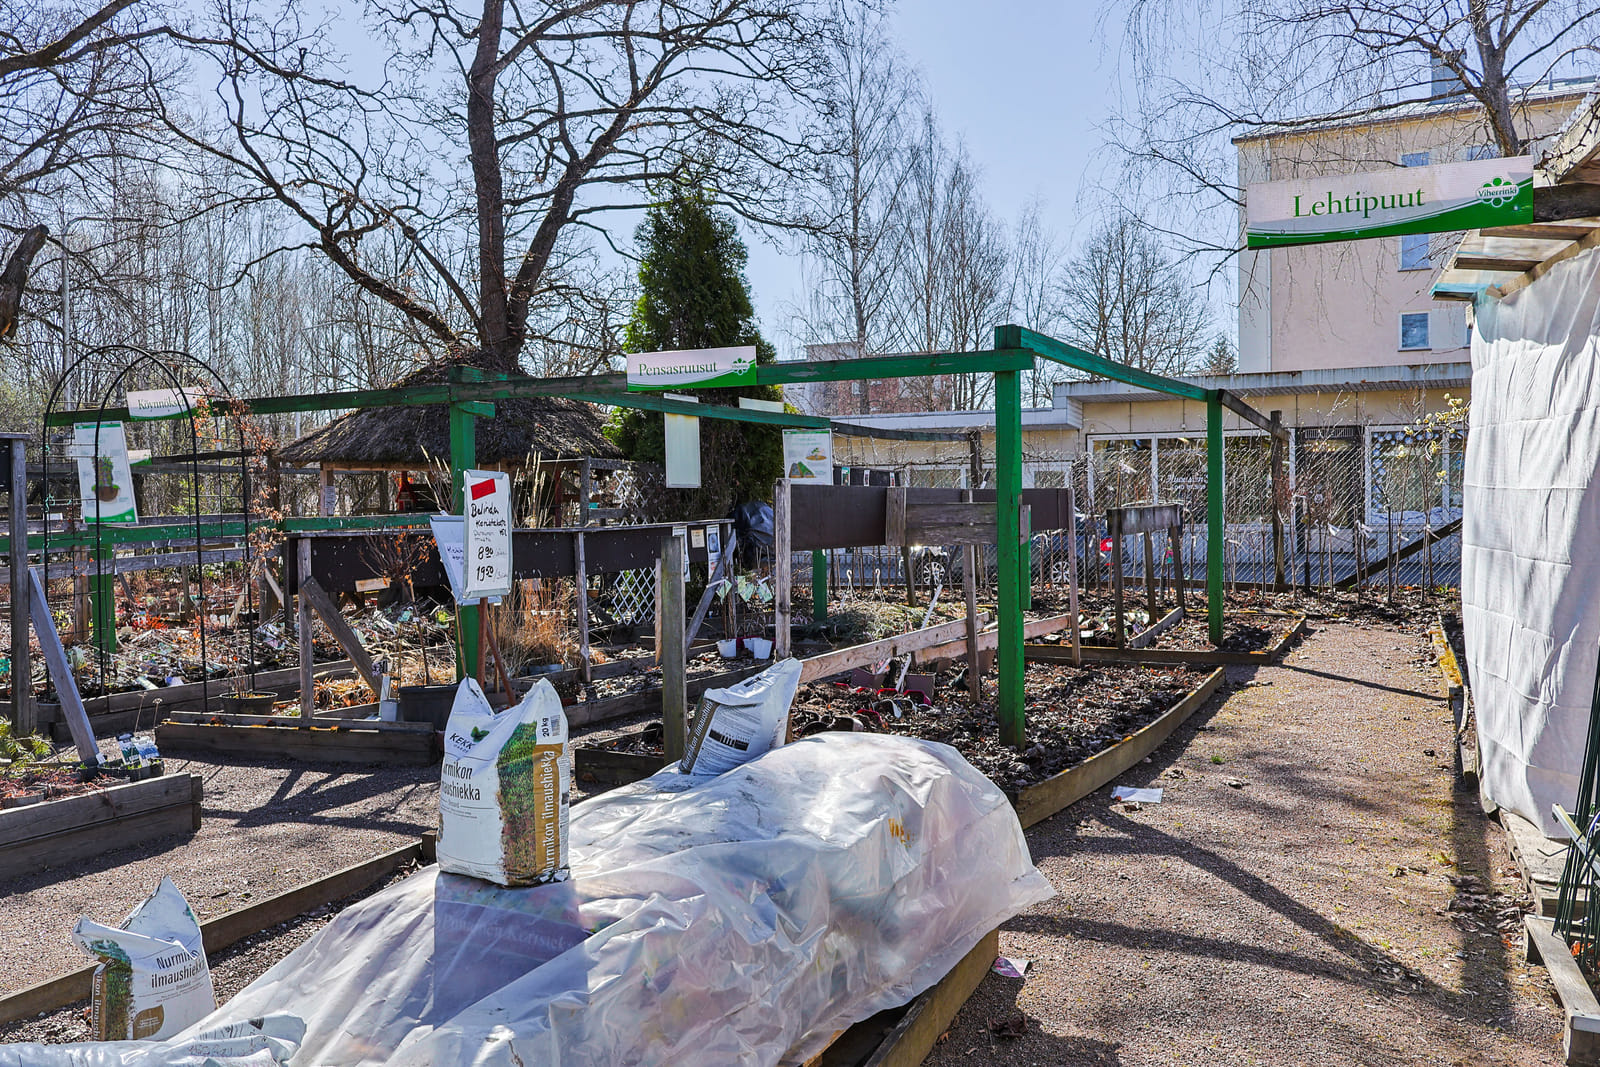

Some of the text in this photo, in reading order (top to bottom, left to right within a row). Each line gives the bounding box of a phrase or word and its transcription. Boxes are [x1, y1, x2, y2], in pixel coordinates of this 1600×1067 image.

[1292, 187, 1425, 219] Lehtipuut
[638, 361, 718, 377] Pensasruusut
[449, 732, 476, 750] KEKK
[540, 750, 556, 819] ilmaushiekka
